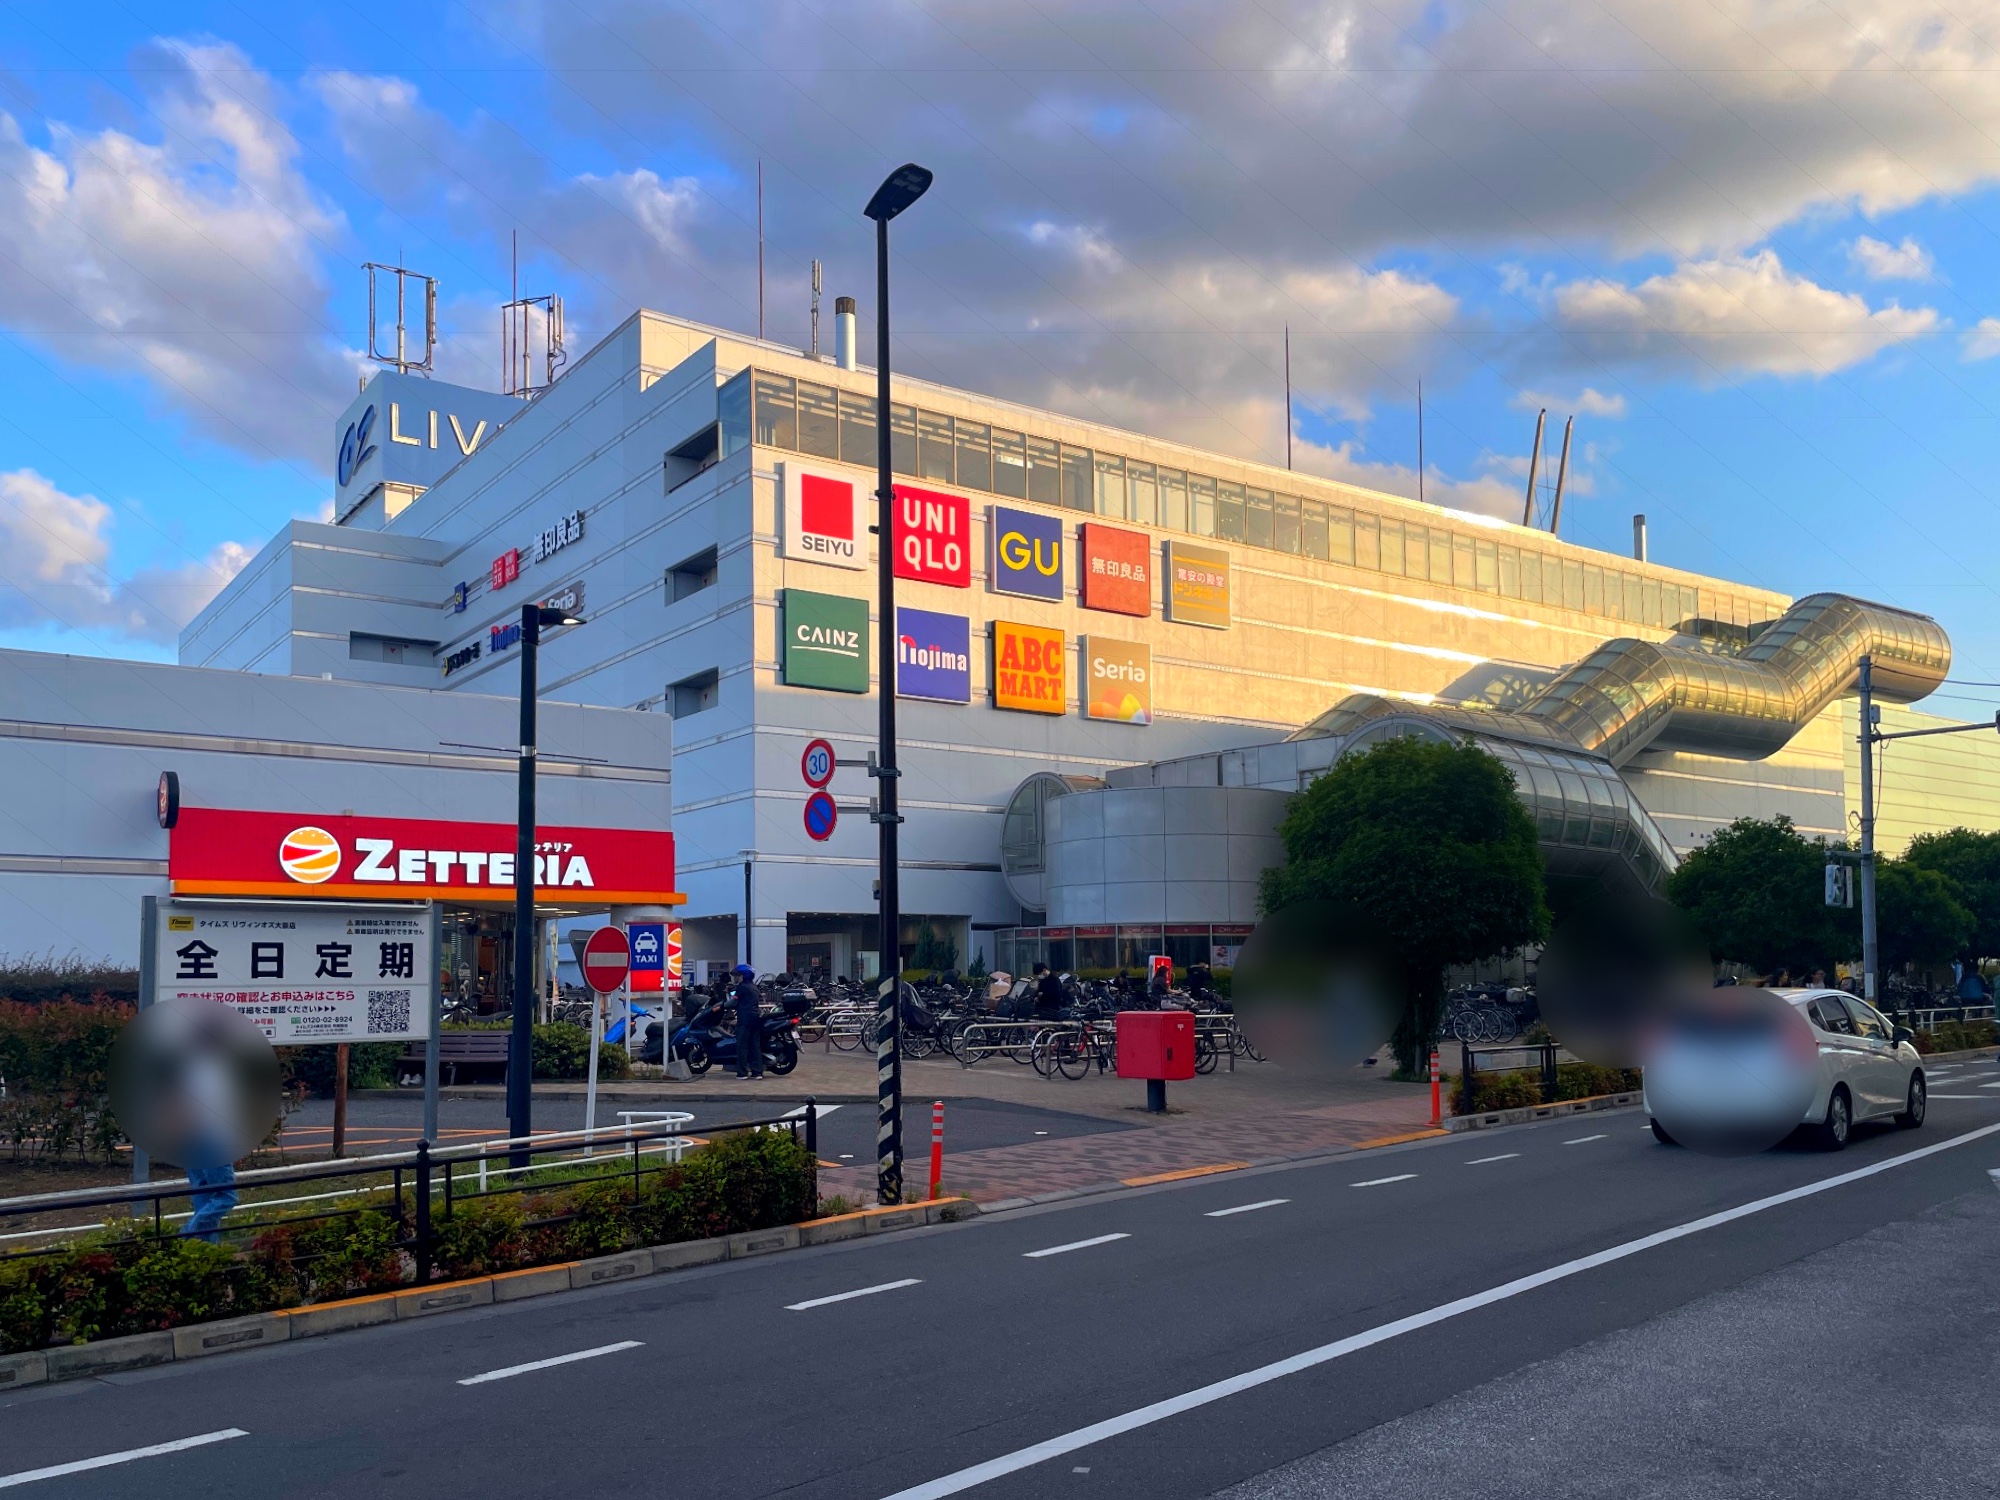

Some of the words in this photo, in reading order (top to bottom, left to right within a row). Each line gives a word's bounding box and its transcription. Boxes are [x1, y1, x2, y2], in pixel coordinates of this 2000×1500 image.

[390, 403, 503, 456] LIV
[903, 497, 956, 536] UNI
[533, 510, 582, 564] 無印良品
[801, 534, 854, 558] SEIYU
[903, 535, 961, 572] QLO
[1000, 531, 1059, 576] GU
[1091, 556, 1146, 583] 無印良品
[797, 624, 859, 648] CAINZ
[1000, 633, 1061, 675] ABC
[1093, 657, 1146, 683] Seria
[1000, 671, 1061, 701] MART
[809, 752, 828, 776] 30
[199, 920, 230, 928] タイムズ
[635, 955, 658, 963] TAXI
